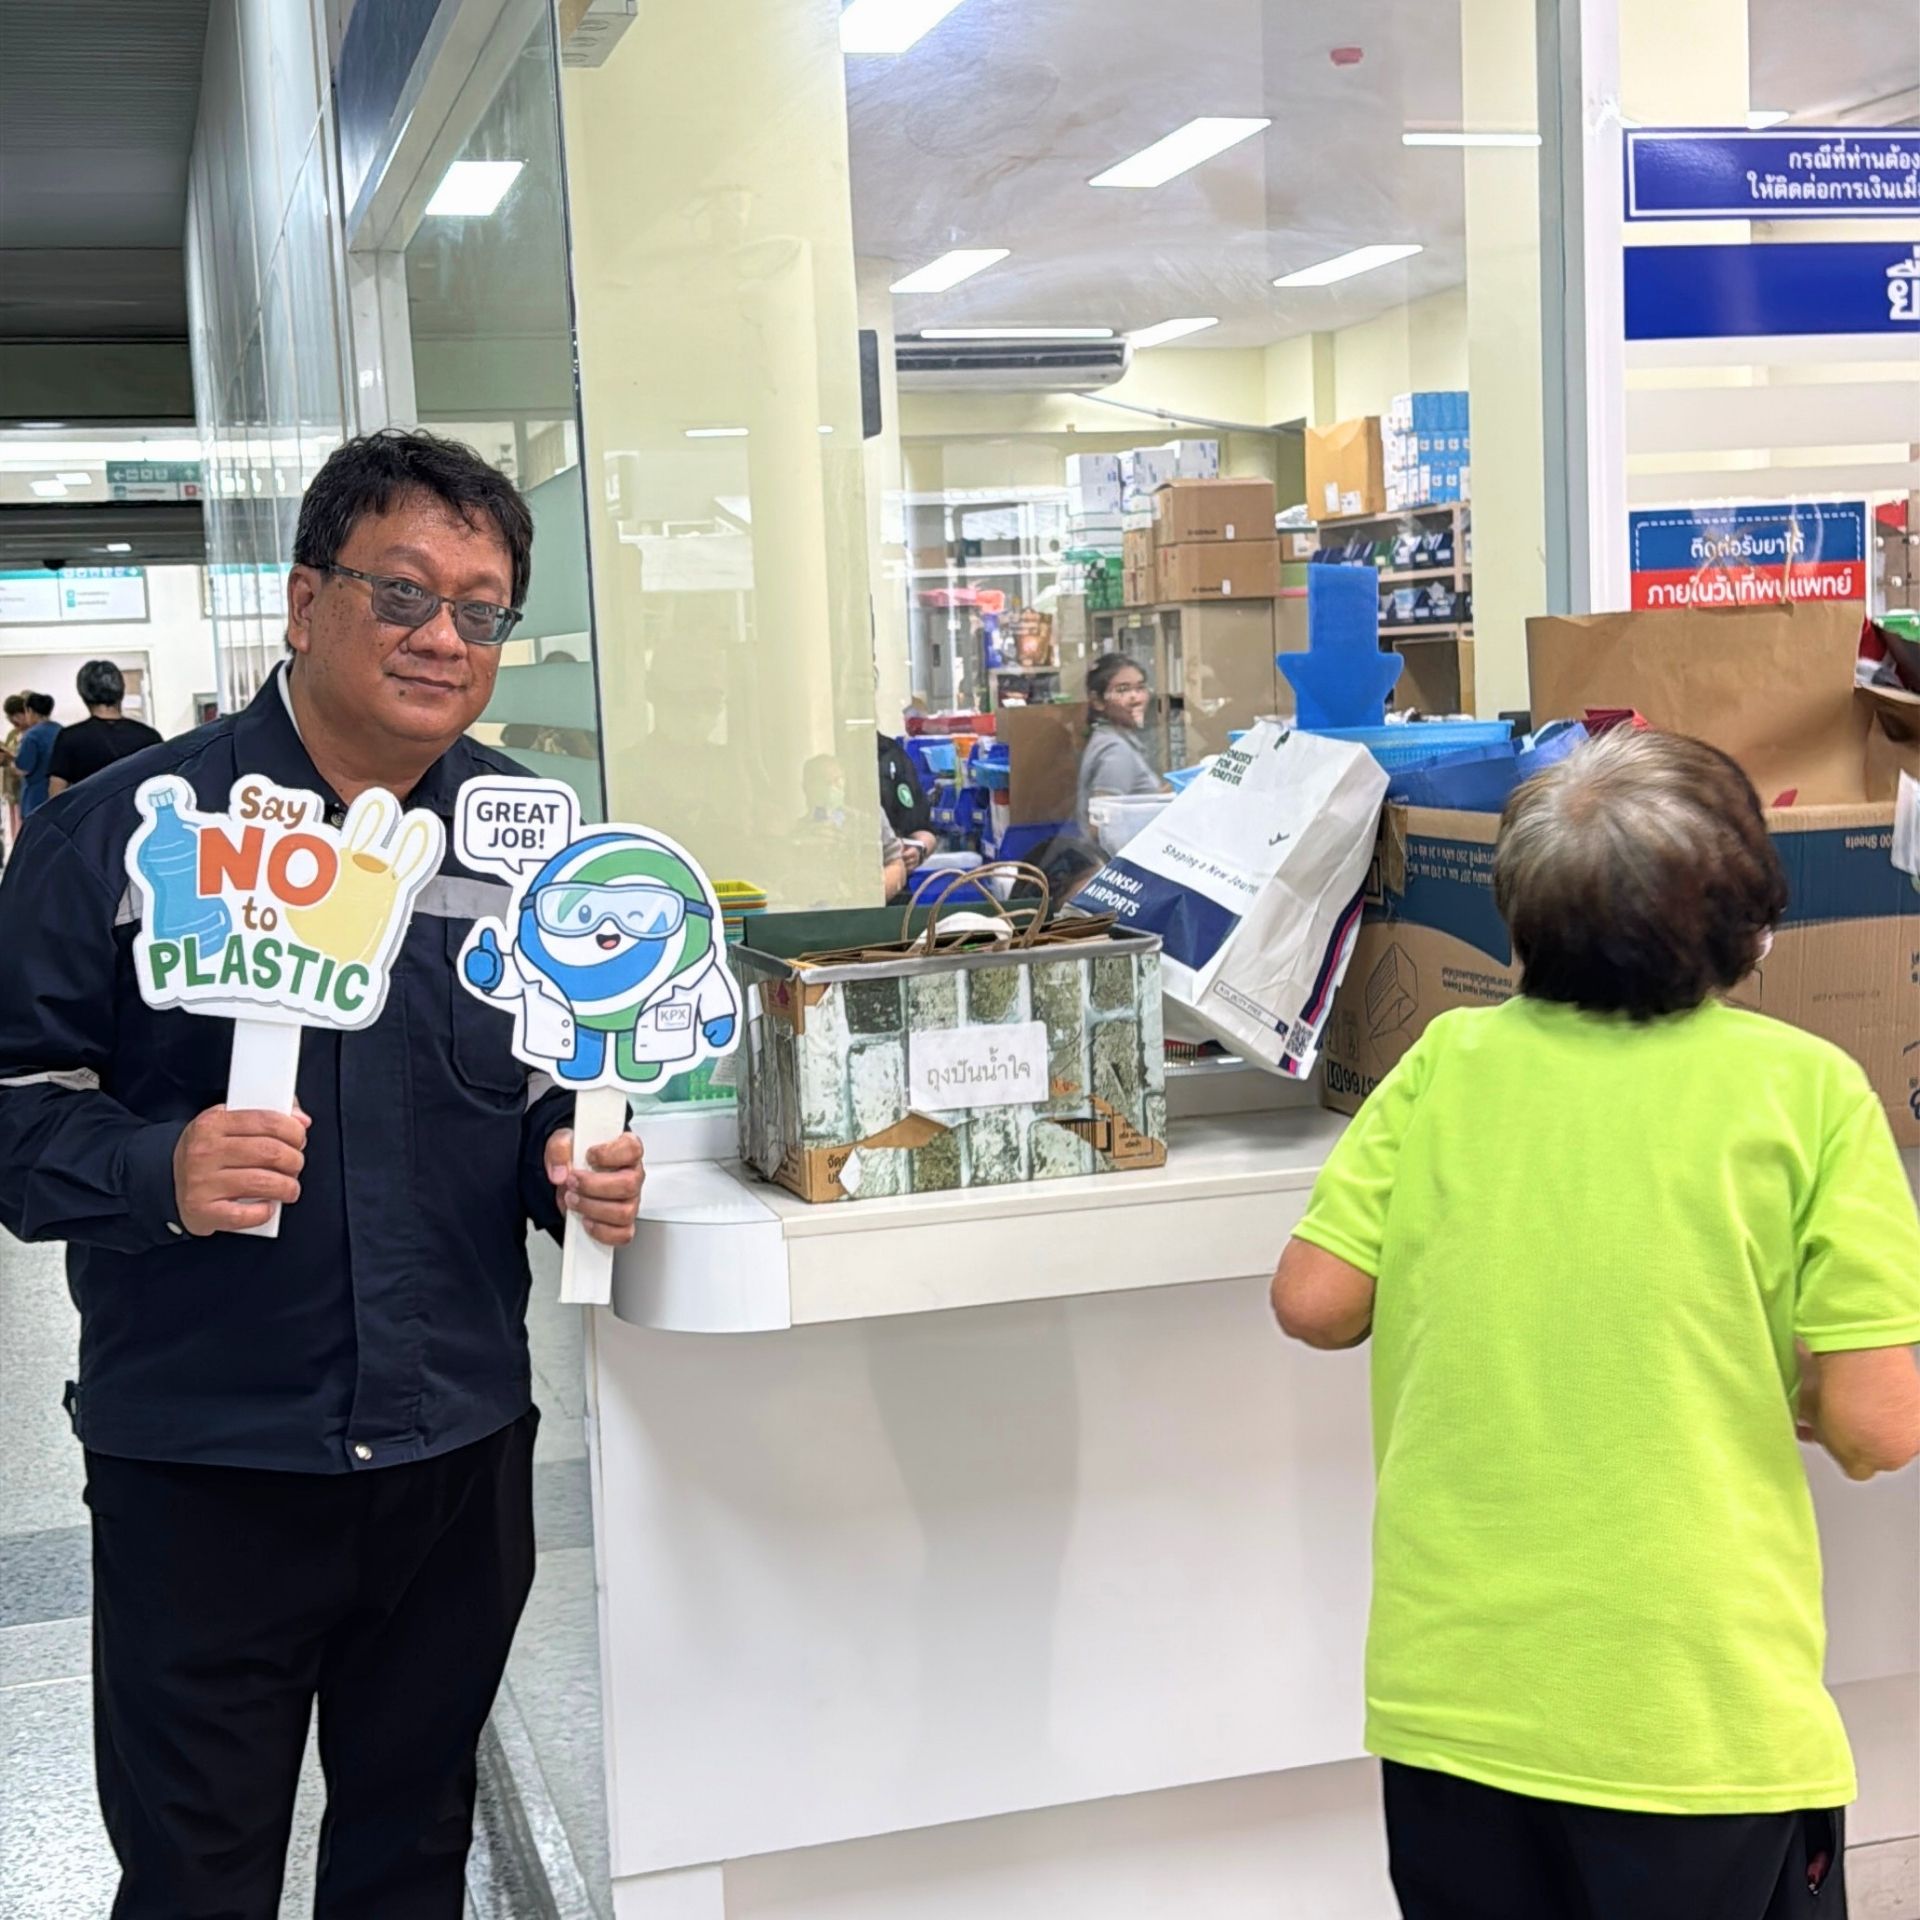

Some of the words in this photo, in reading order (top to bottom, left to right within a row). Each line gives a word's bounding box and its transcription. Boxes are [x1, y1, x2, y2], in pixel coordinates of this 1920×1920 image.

[1746, 170, 1920, 199] ให้ติดต่อการเงินเมื่
[240, 786, 307, 830] Say
[476, 801, 560, 824] GREAT
[488, 827, 545, 850] JOB!
[200, 825, 338, 907] NO
[1162, 844, 1198, 869] Shaping
[1100, 866, 1144, 895] KANSAI
[242, 896, 278, 932] to
[1084, 884, 1141, 918] AIRPORTS
[148, 934, 370, 1011] PLASTIC
[660, 1009, 687, 1021] KPX
[927, 1047, 1031, 1092] ถุงปันน้ำใจ
